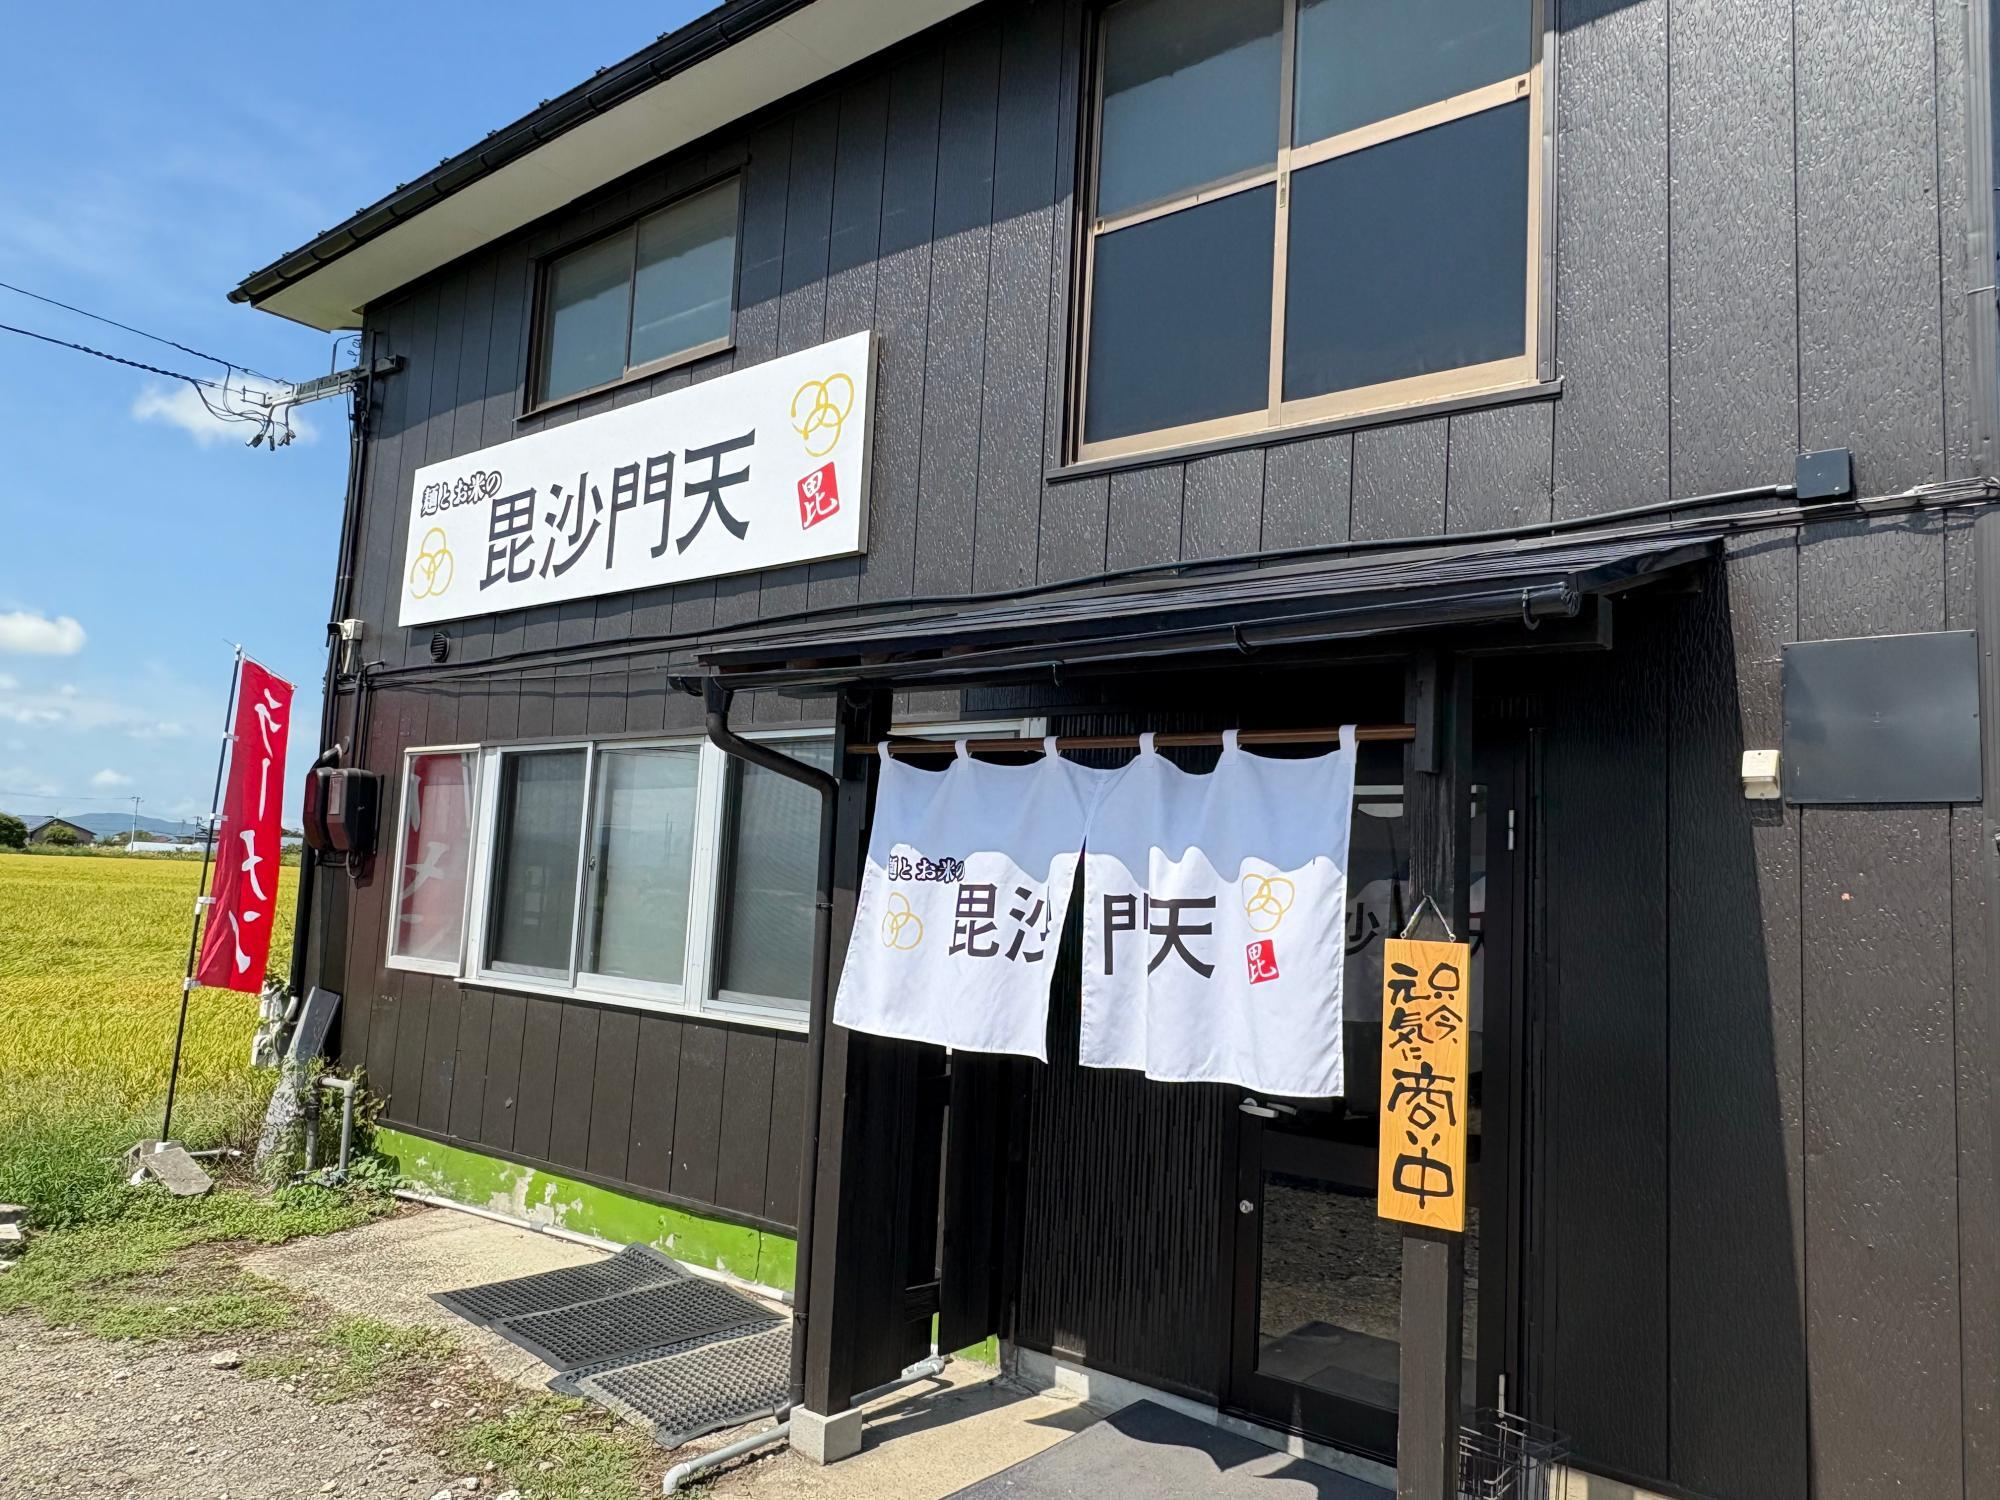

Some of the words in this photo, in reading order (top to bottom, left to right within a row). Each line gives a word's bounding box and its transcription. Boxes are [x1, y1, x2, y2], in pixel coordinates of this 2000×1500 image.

[420, 470, 503, 518] 麺とお米の
[479, 428, 756, 591] 毘沙門天
[1386, 1061, 1457, 1210] 商い中
